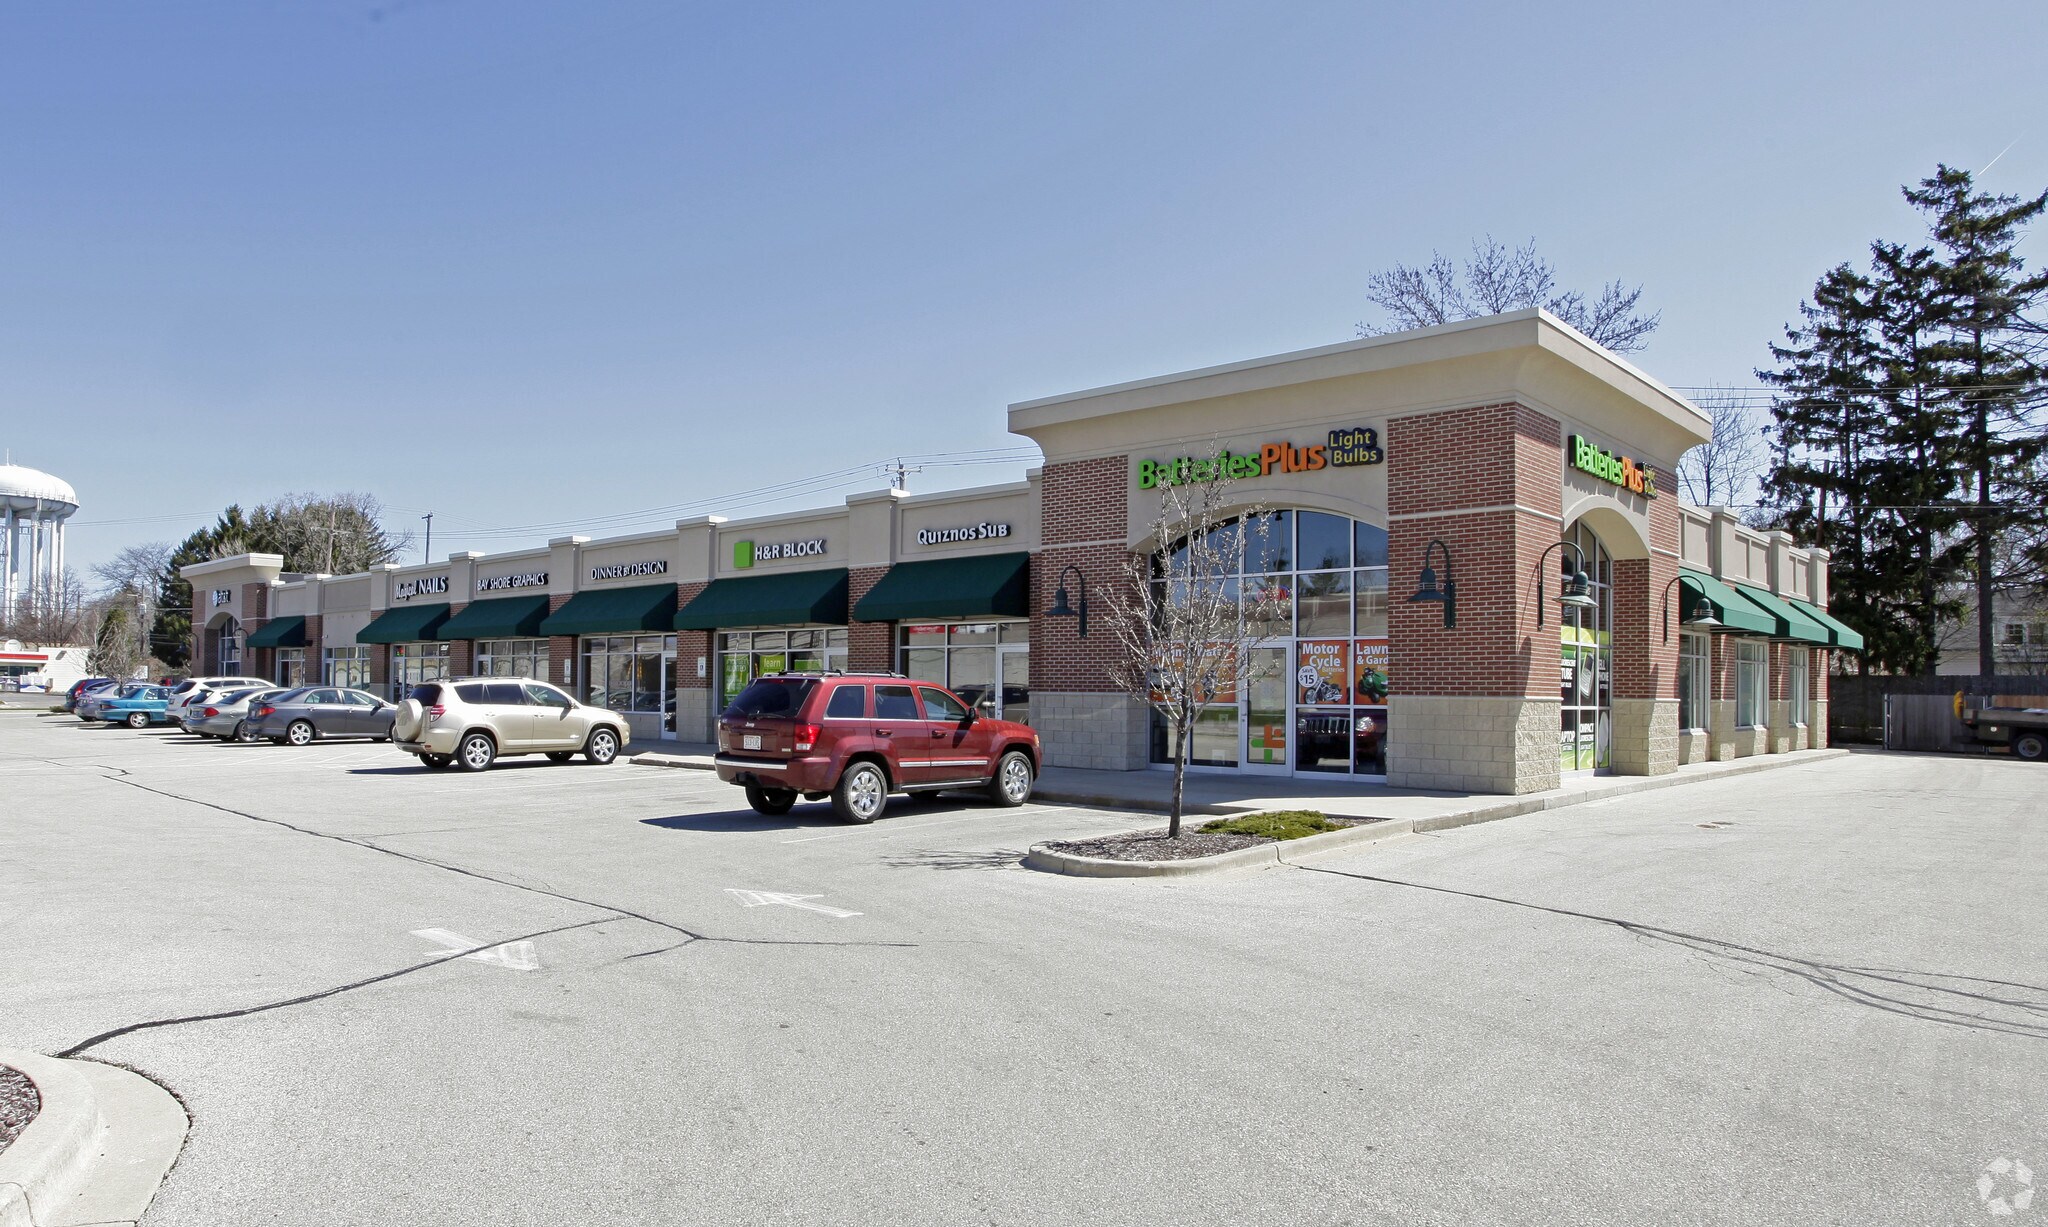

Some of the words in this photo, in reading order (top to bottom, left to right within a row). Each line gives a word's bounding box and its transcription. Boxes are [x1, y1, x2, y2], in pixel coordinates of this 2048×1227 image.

[1330, 431, 1371, 449] Light
[1333, 447, 1377, 464] Bulbs
[755, 546, 780, 561] H&R
[783, 539, 824, 558] BLOCK
[591, 565, 622, 580] DINNER
[623, 565, 630, 577] BY
[631, 561, 665, 576] DESIGN
[395, 580, 418, 600] Magical
[419, 576, 446, 594] NAILS
[477, 579, 488, 591] BAY
[490, 576, 511, 590] SHORE
[512, 573, 545, 588] GRAPHICS
[1302, 642, 1340, 655] Motor
[1356, 643, 1388, 655] Lawn
[764, 658, 781, 670] learn
[1309, 655, 1341, 670] Cycle
[1356, 655, 1364, 665] &
[1366, 655, 1388, 665] Gard
